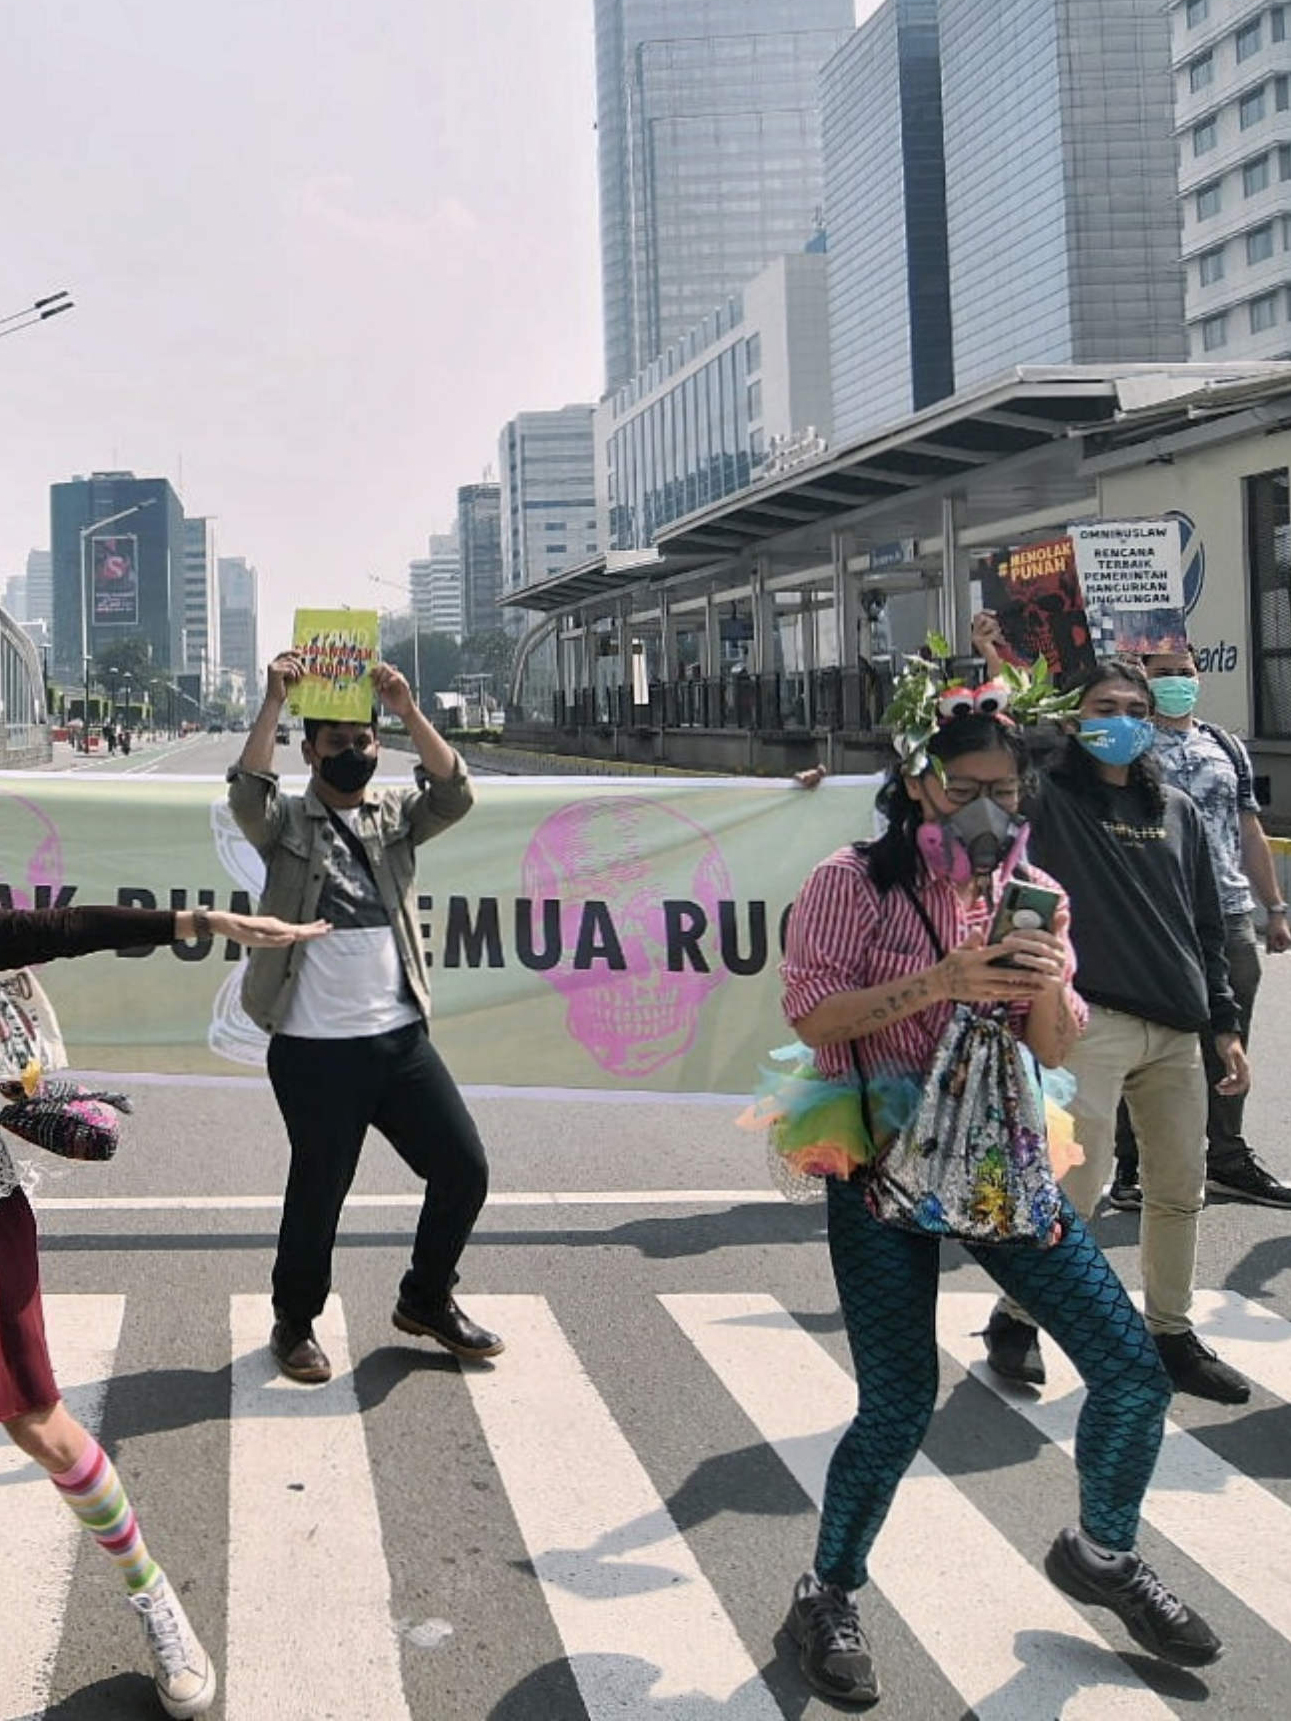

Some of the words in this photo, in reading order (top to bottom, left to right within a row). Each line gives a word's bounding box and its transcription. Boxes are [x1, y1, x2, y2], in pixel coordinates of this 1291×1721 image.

[1011, 542, 1072, 567] MENOLAK
[1097, 560, 1152, 570] TERBAIK
[1011, 556, 1067, 582] PUNAH
[1084, 571, 1168, 581] PEMERINTAH
[1086, 582, 1168, 593] HANCURKAN
[1196, 640, 1238, 674] arta
[662, 900, 799, 976] RU
